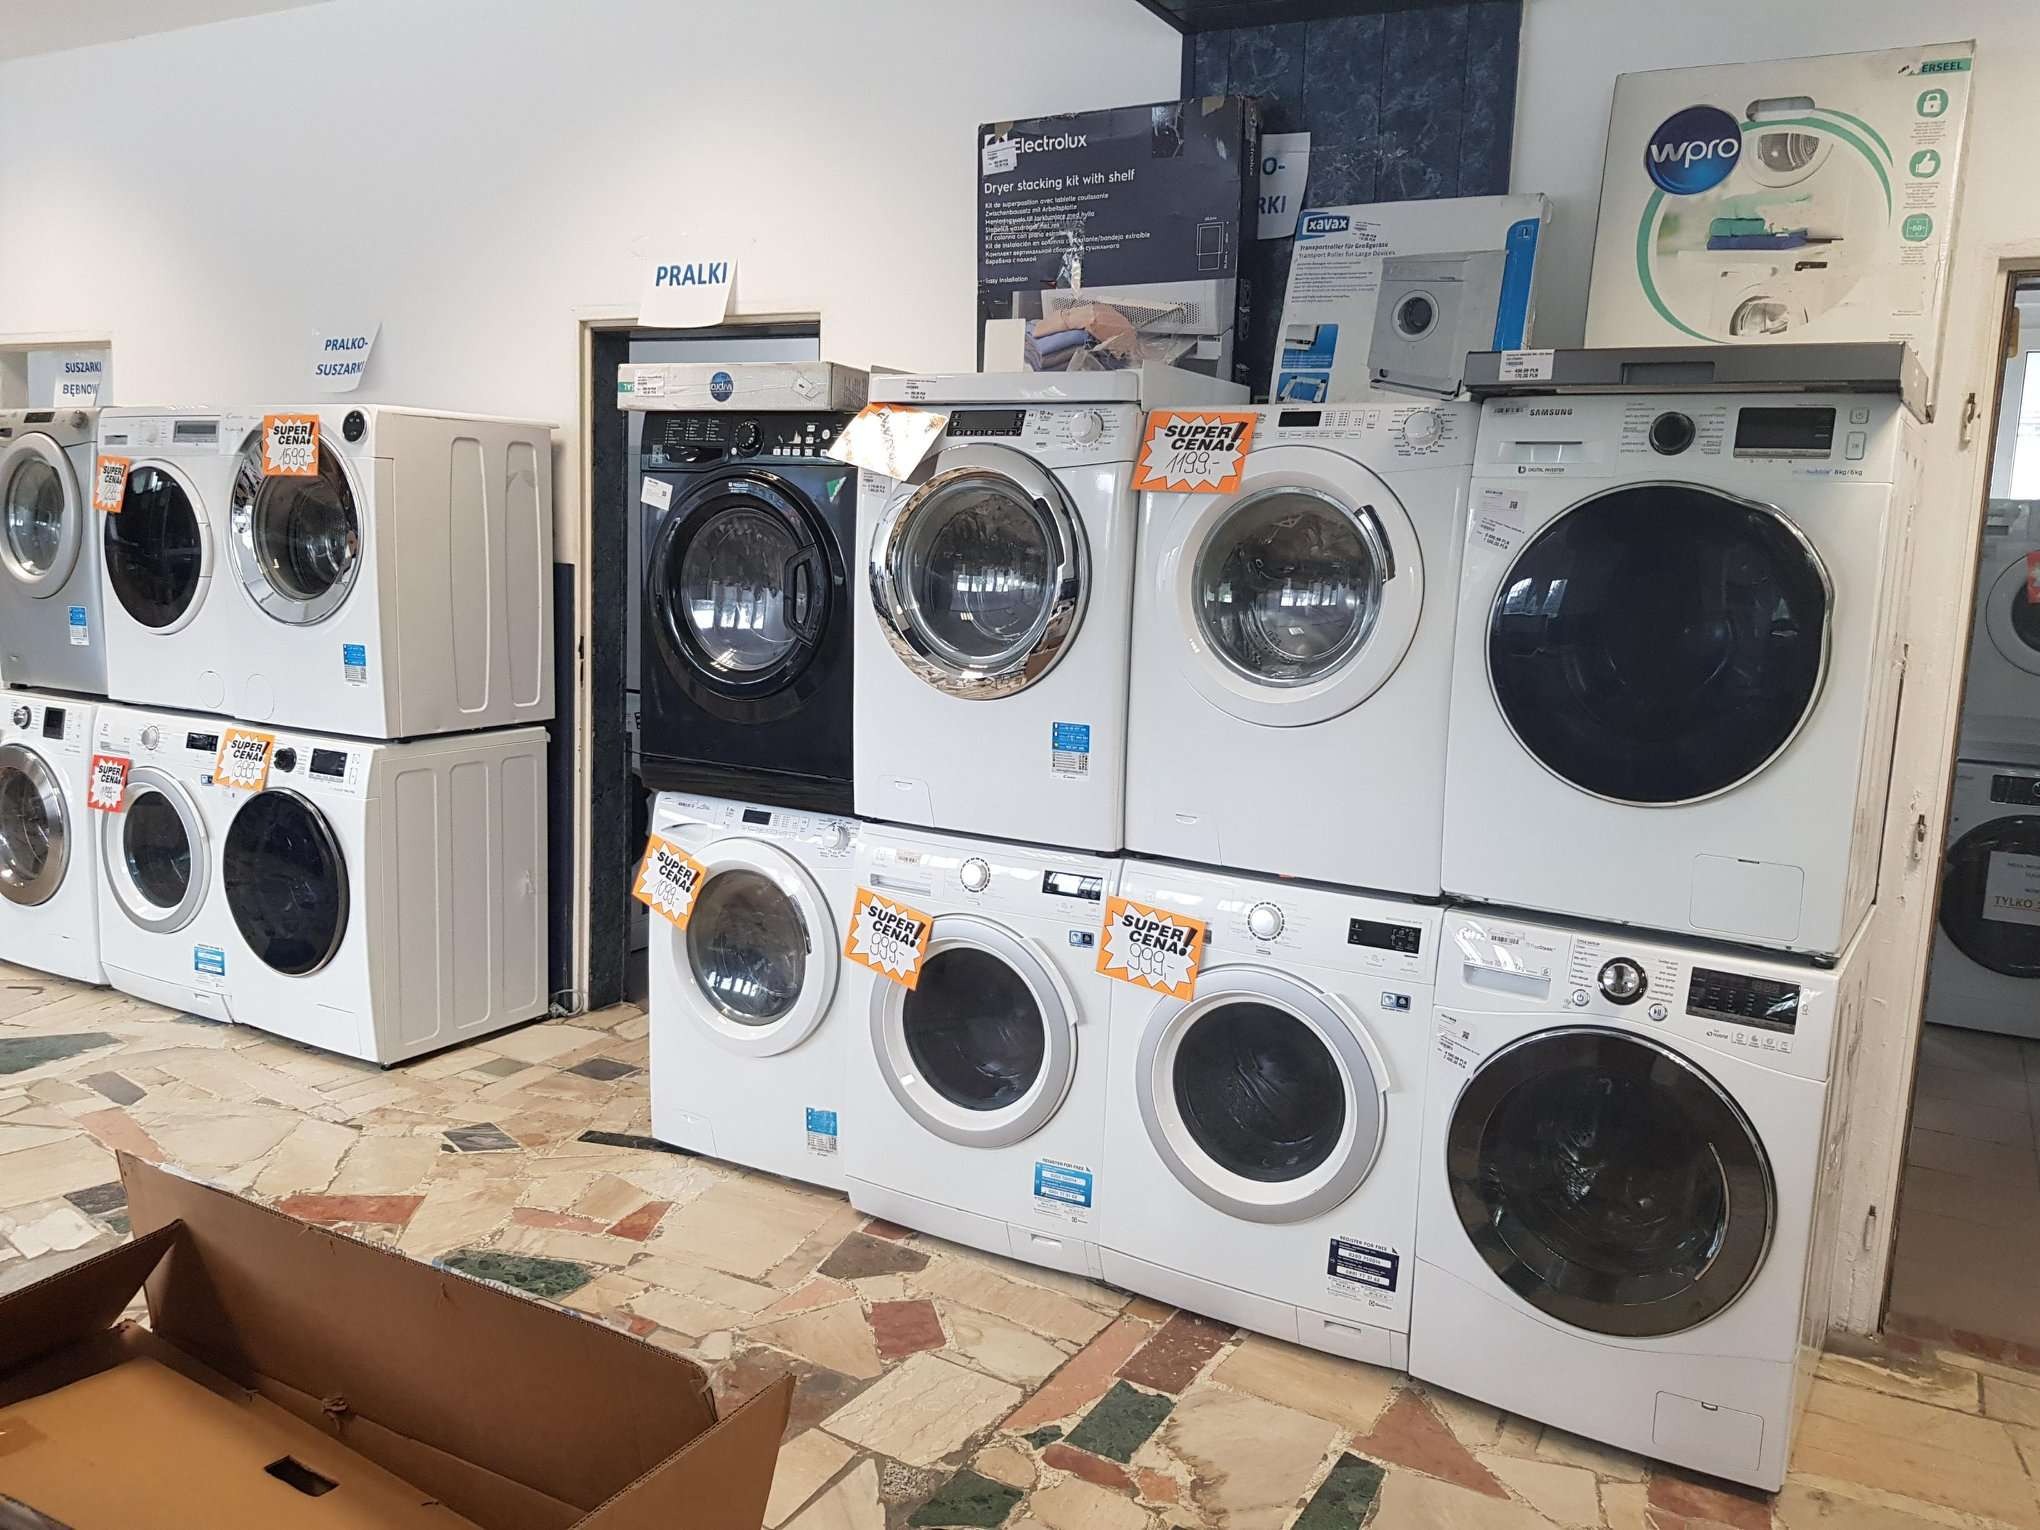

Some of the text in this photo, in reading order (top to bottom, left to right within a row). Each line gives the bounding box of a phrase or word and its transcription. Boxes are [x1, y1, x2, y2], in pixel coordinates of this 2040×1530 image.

[1013, 132, 1087, 154] Electrolux
[1650, 138, 1739, 168] wpro
[984, 169, 1135, 195] Dryer stacking kit with shelf
[1308, 218, 1348, 230] xavax
[655, 262, 728, 287] PRALKI
[325, 336, 368, 351] PRALKO-
[65, 361, 102, 373] SUSZARKI
[1529, 408, 1574, 417] SAMSUNG
[273, 425, 308, 436] SUPER
[1164, 425, 1233, 439] SUPER
[231, 739, 263, 753] SUPER
[98, 765, 121, 776] SUPER
[657, 851, 692, 881] SUPER
[868, 906, 915, 934] SUPER
[1121, 914, 1184, 942] SUPER
